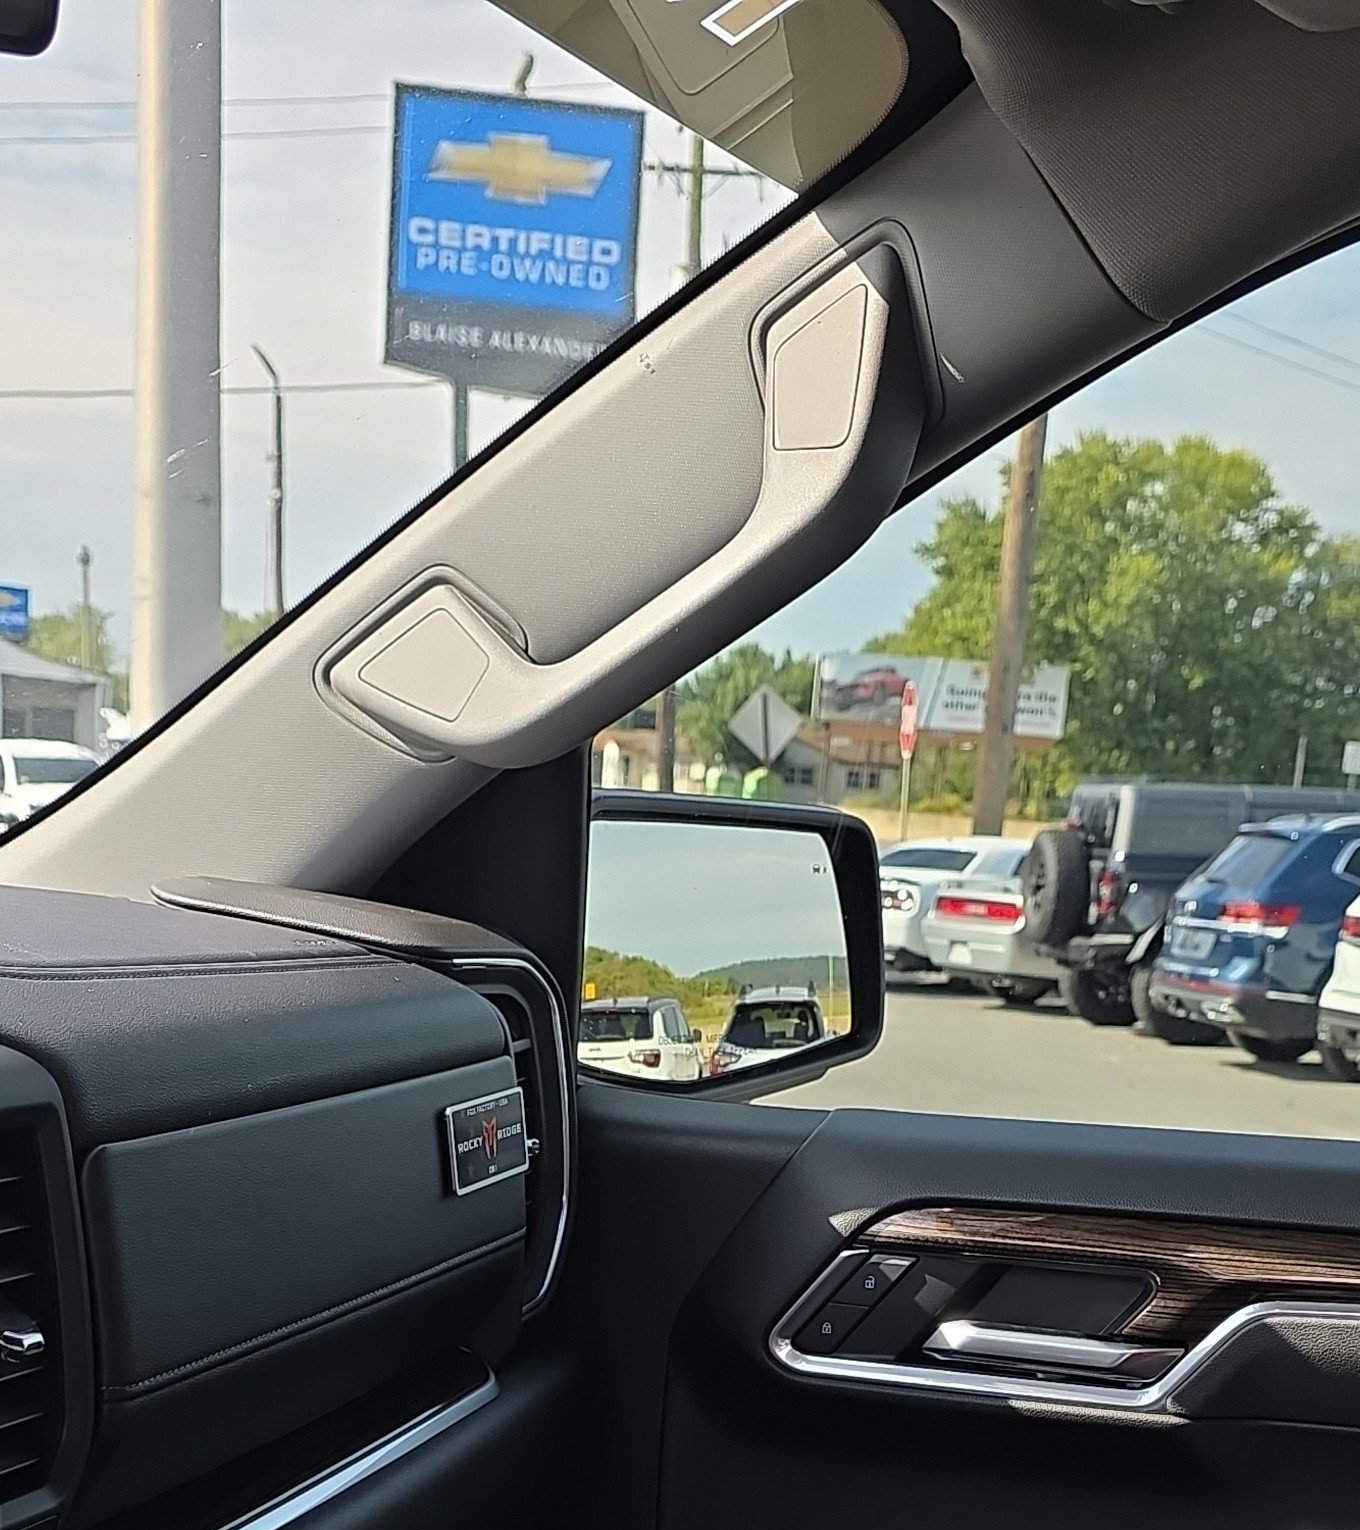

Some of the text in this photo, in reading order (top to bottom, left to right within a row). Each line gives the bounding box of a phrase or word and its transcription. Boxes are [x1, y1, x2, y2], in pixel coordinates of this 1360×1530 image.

[408, 216, 622, 266] CERTIFIED
[416, 246, 611, 291] PRE-OWNED
[409, 320, 485, 349] BLAISE
[457, 1123, 522, 1154] ROCKY RIDGE
